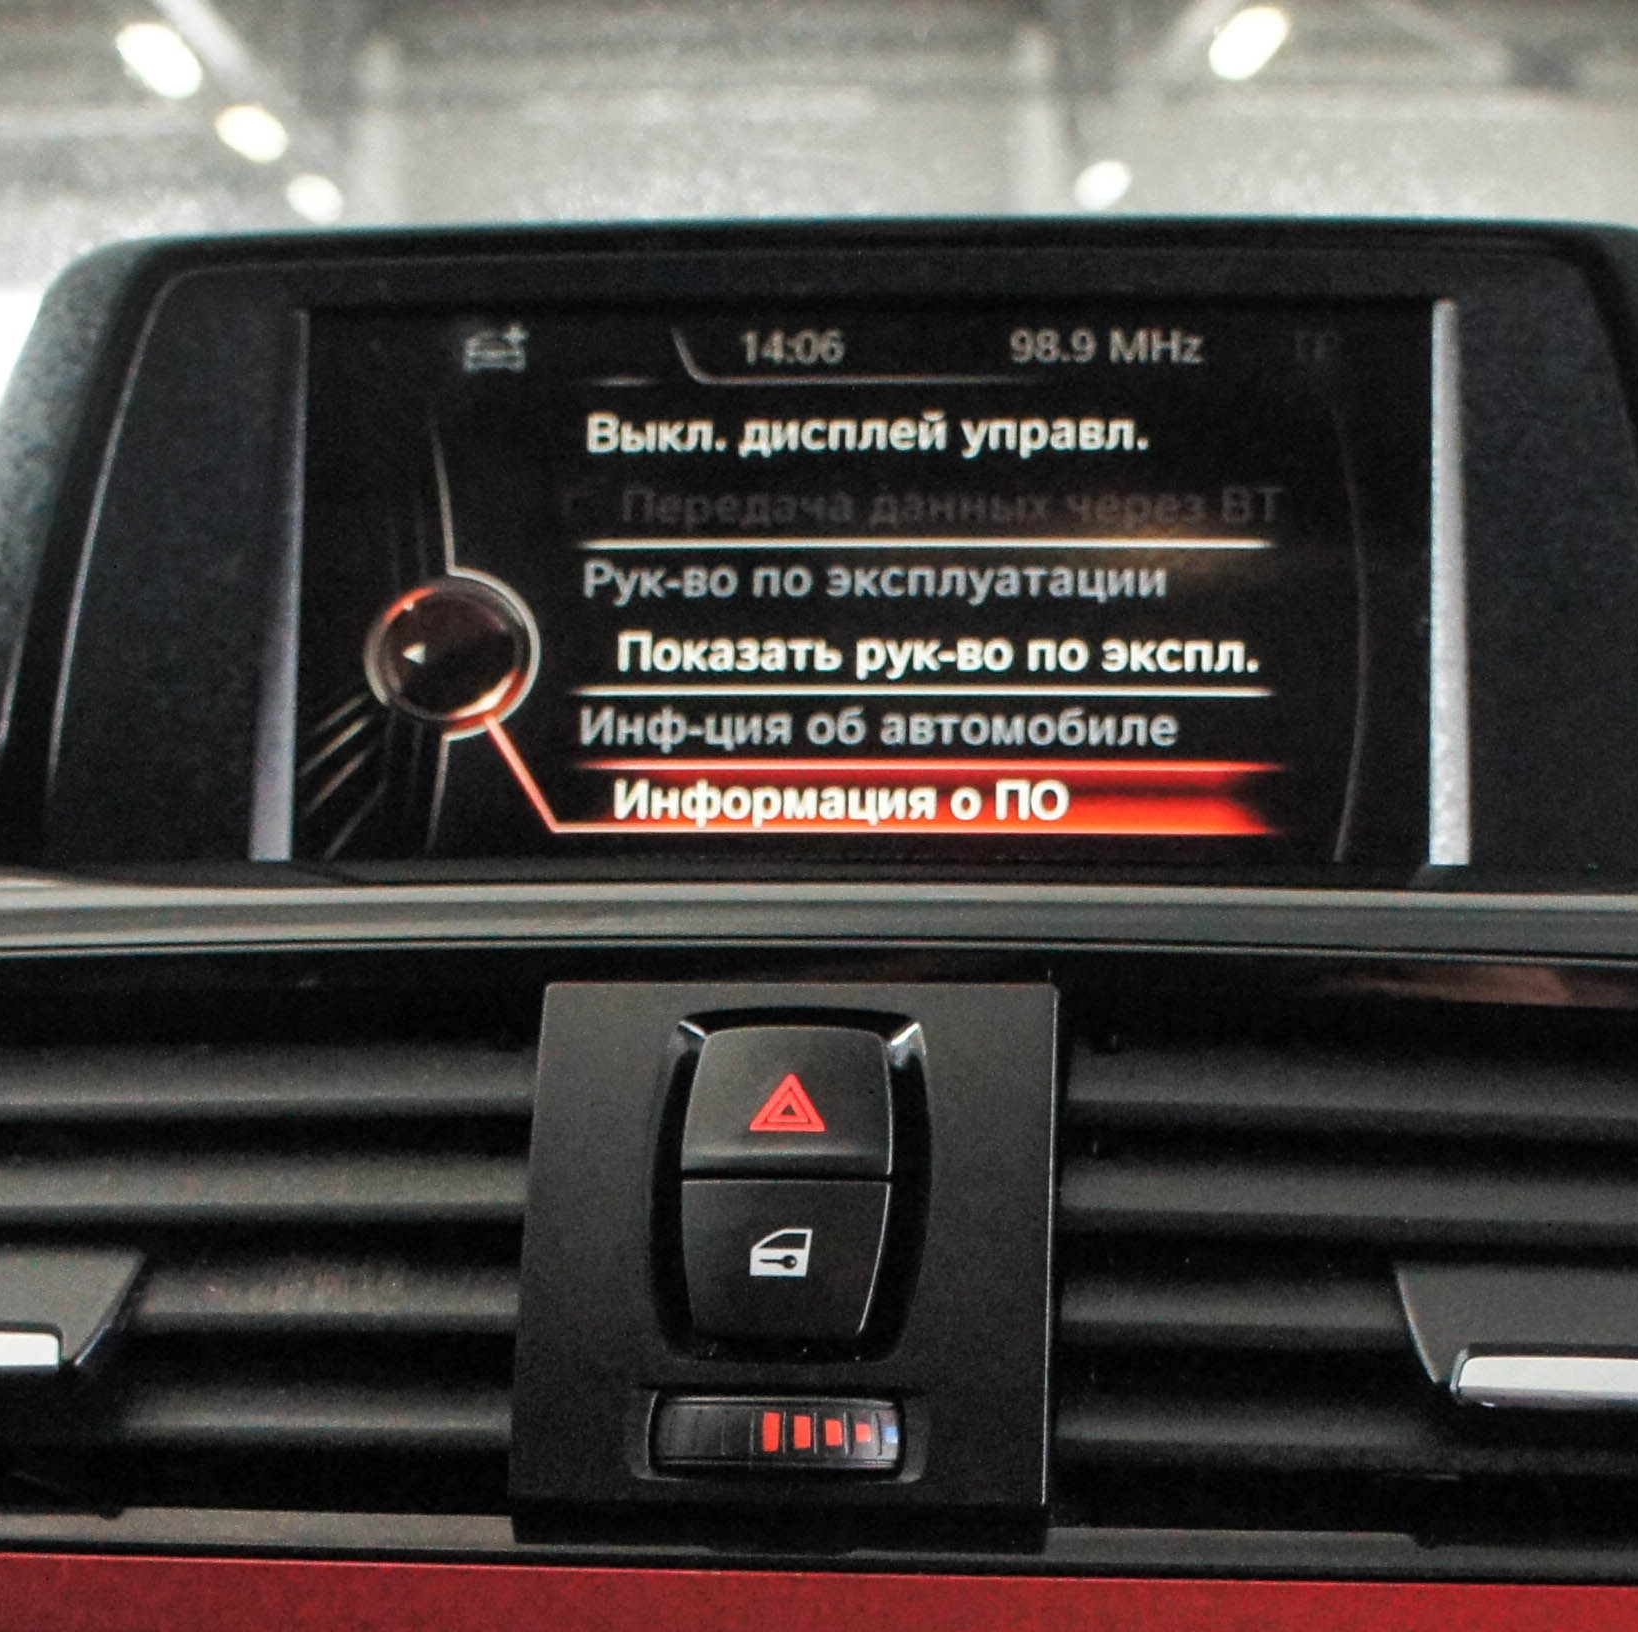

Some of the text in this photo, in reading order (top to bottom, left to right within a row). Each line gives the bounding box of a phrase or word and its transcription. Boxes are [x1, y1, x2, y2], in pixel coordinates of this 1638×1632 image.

[742, 329, 845, 365] 14:06
[1009, 328, 1204, 364] 98.9 MHz
[586, 410, 1149, 460] Выкл. дисплей управл.
[620, 484, 856, 528] Передача
[869, 491, 1052, 527] данных
[1064, 493, 1208, 529] через
[583, 560, 1168, 606] Рук-во по эксплуатации
[617, 629, 1259, 681] Показать рук-во по экспл.
[580, 705, 1178, 753] Инф-ция об автомобиле
[614, 779, 1070, 827] Информация о ПО
